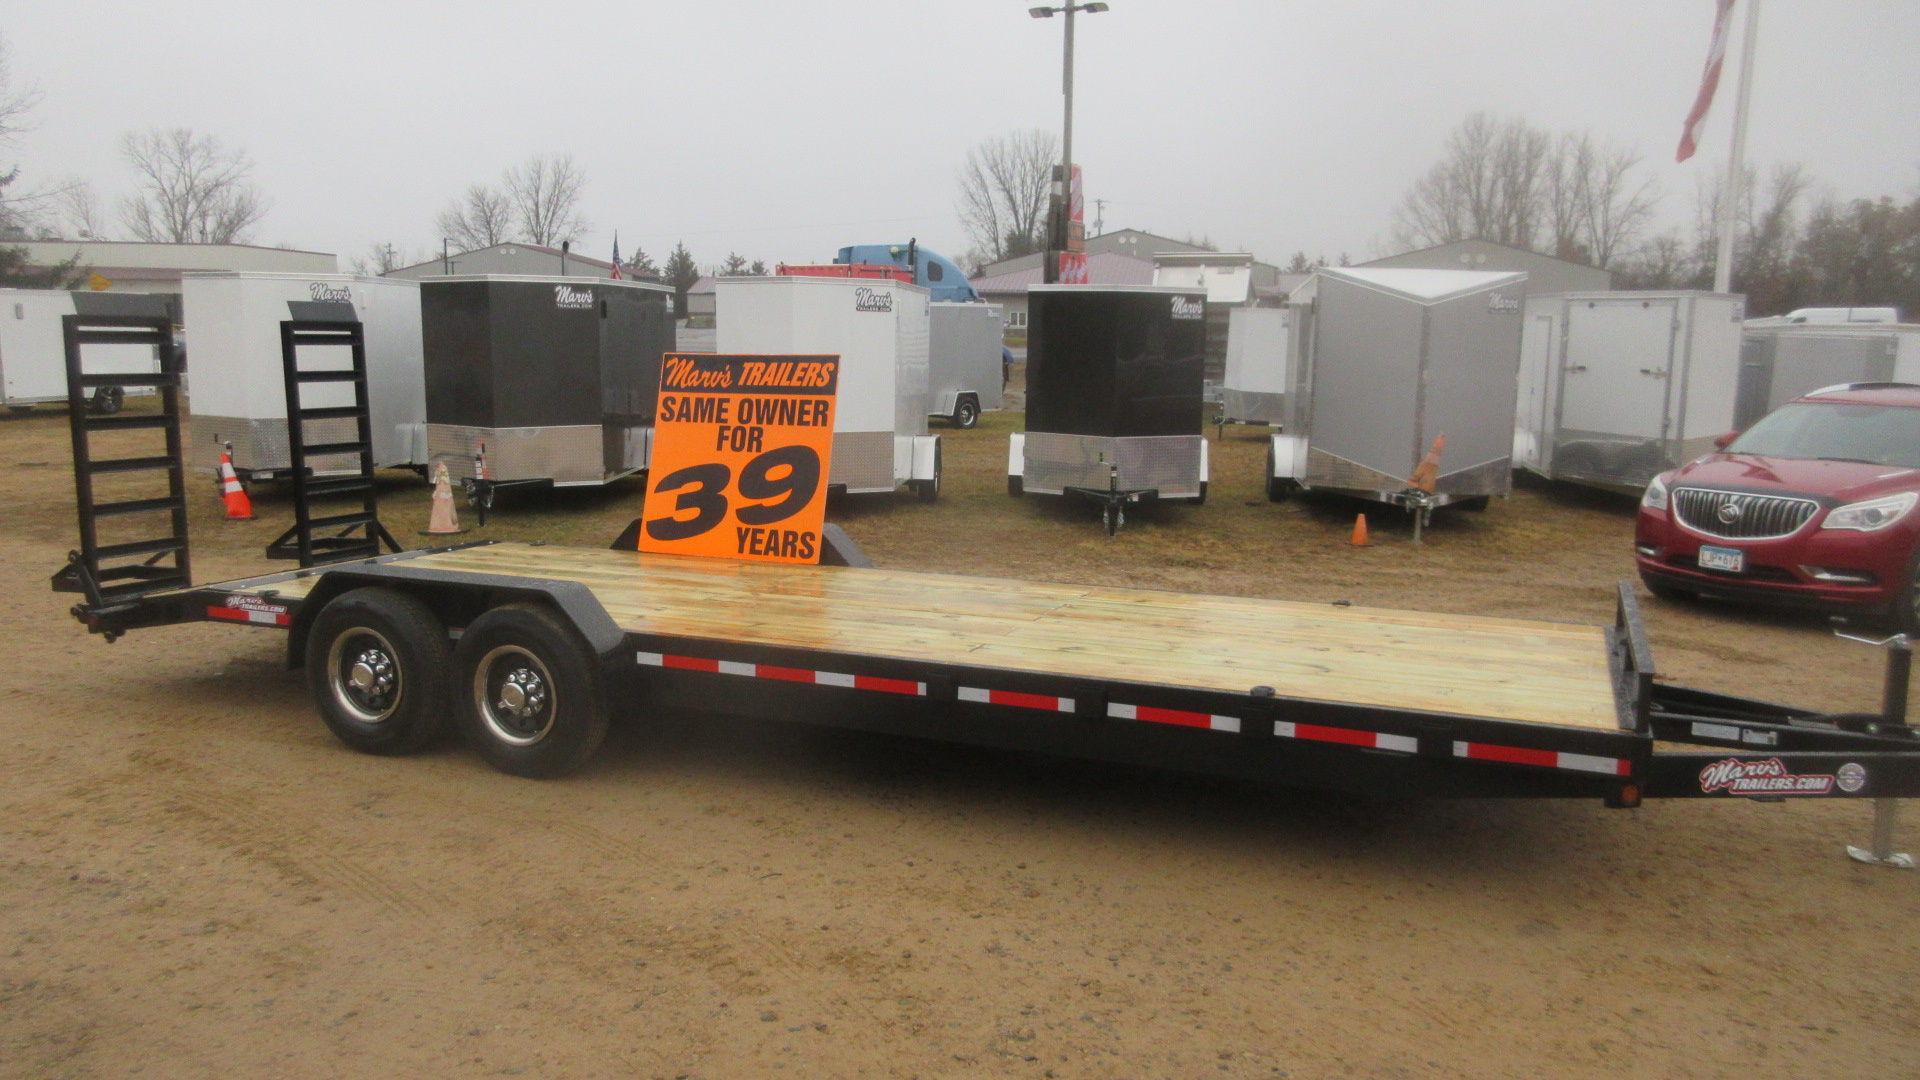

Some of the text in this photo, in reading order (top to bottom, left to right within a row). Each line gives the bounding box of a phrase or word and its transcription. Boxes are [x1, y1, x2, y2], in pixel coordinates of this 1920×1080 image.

[310, 282, 351, 300] Marv's
[555, 286, 593, 303] Marv's
[855, 287, 892, 306] Marv's
[1171, 296, 1203, 314] Marv's
[666, 357, 835, 388] Marv's TRAILERS
[660, 396, 829, 427] SAME OWNER
[716, 425, 764, 453] FOR
[646, 445, 821, 541] 39
[736, 527, 816, 559] YEARS
[227, 595, 262, 607] Marv's
[241, 603, 285, 613] TRAILERS.COM
[1702, 759, 1783, 789] Marv's
[1732, 777, 1830, 791] TRAILERS.COM
